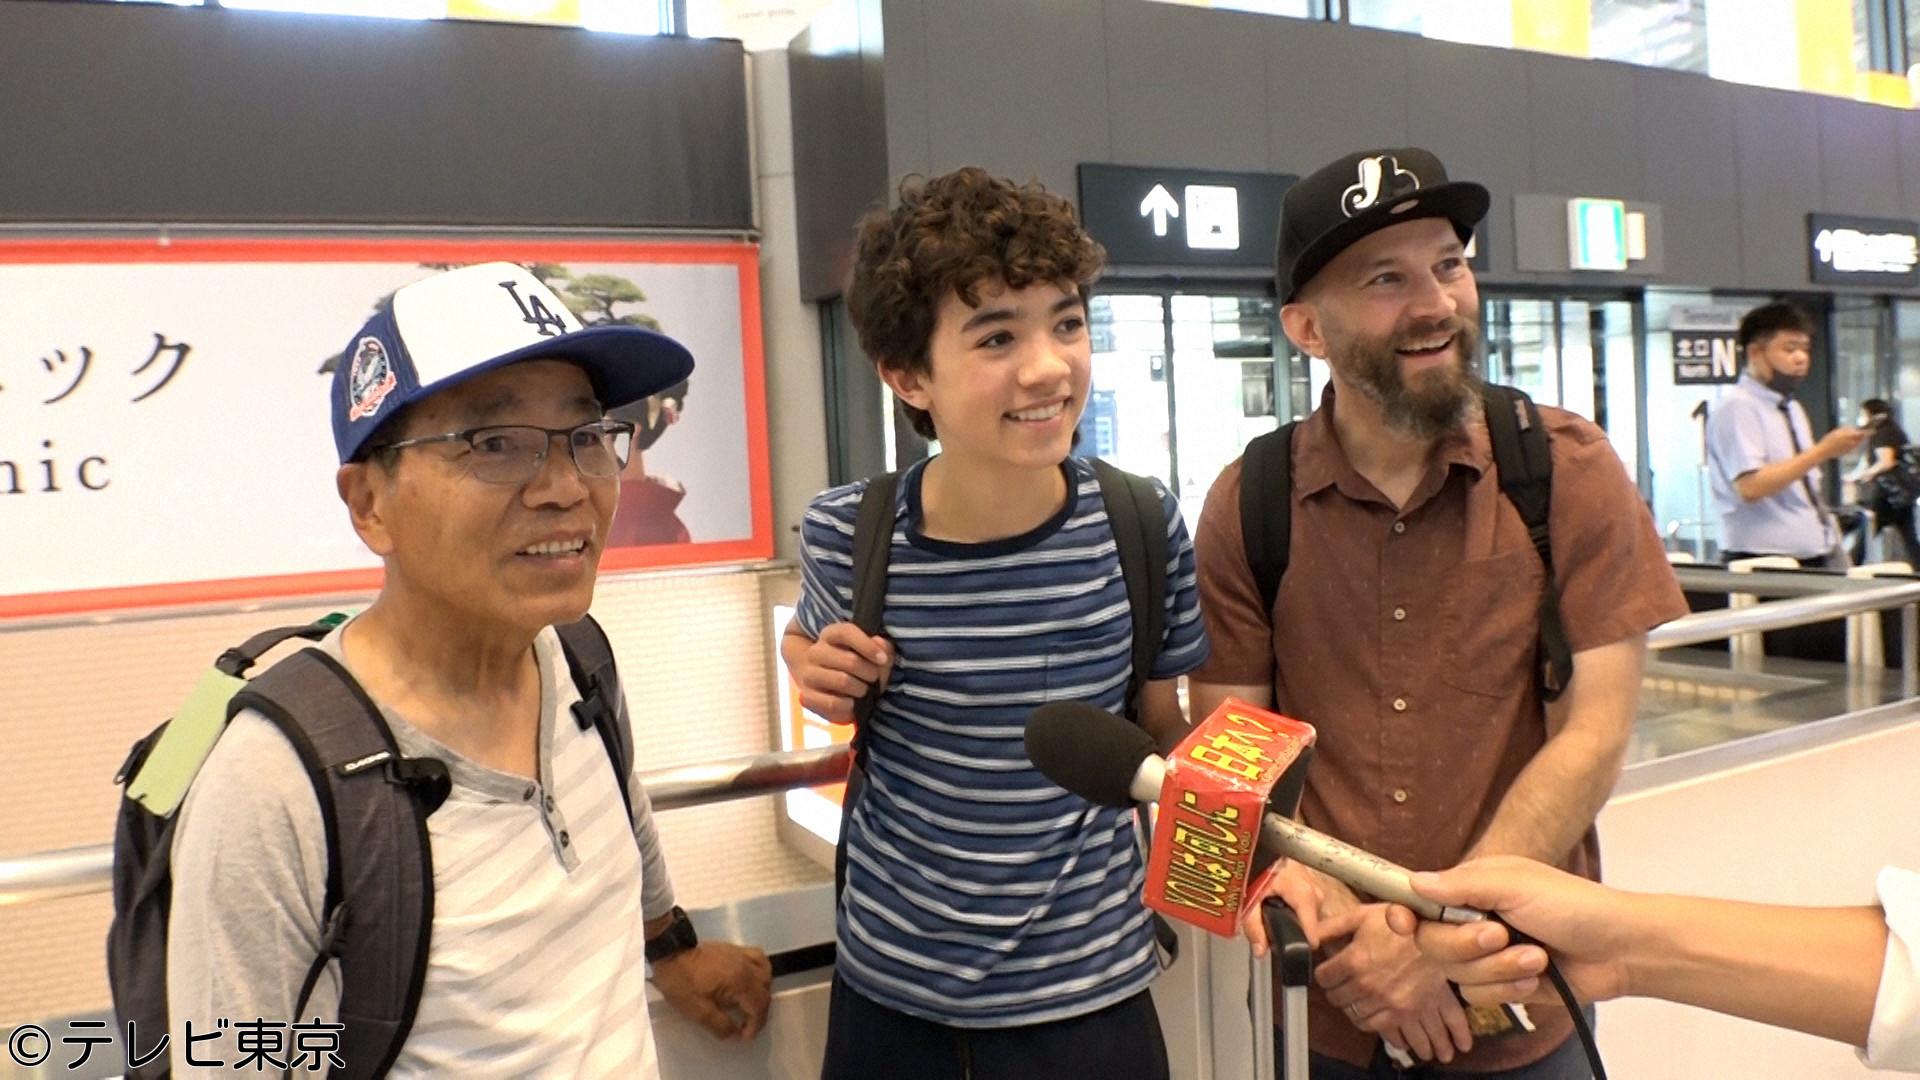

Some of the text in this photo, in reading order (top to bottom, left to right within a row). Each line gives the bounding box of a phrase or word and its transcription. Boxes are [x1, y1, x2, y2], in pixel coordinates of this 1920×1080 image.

[498, 280, 568, 336] LA
[0, 332, 191, 404] ック
[1711, 337, 1737, 378] N
